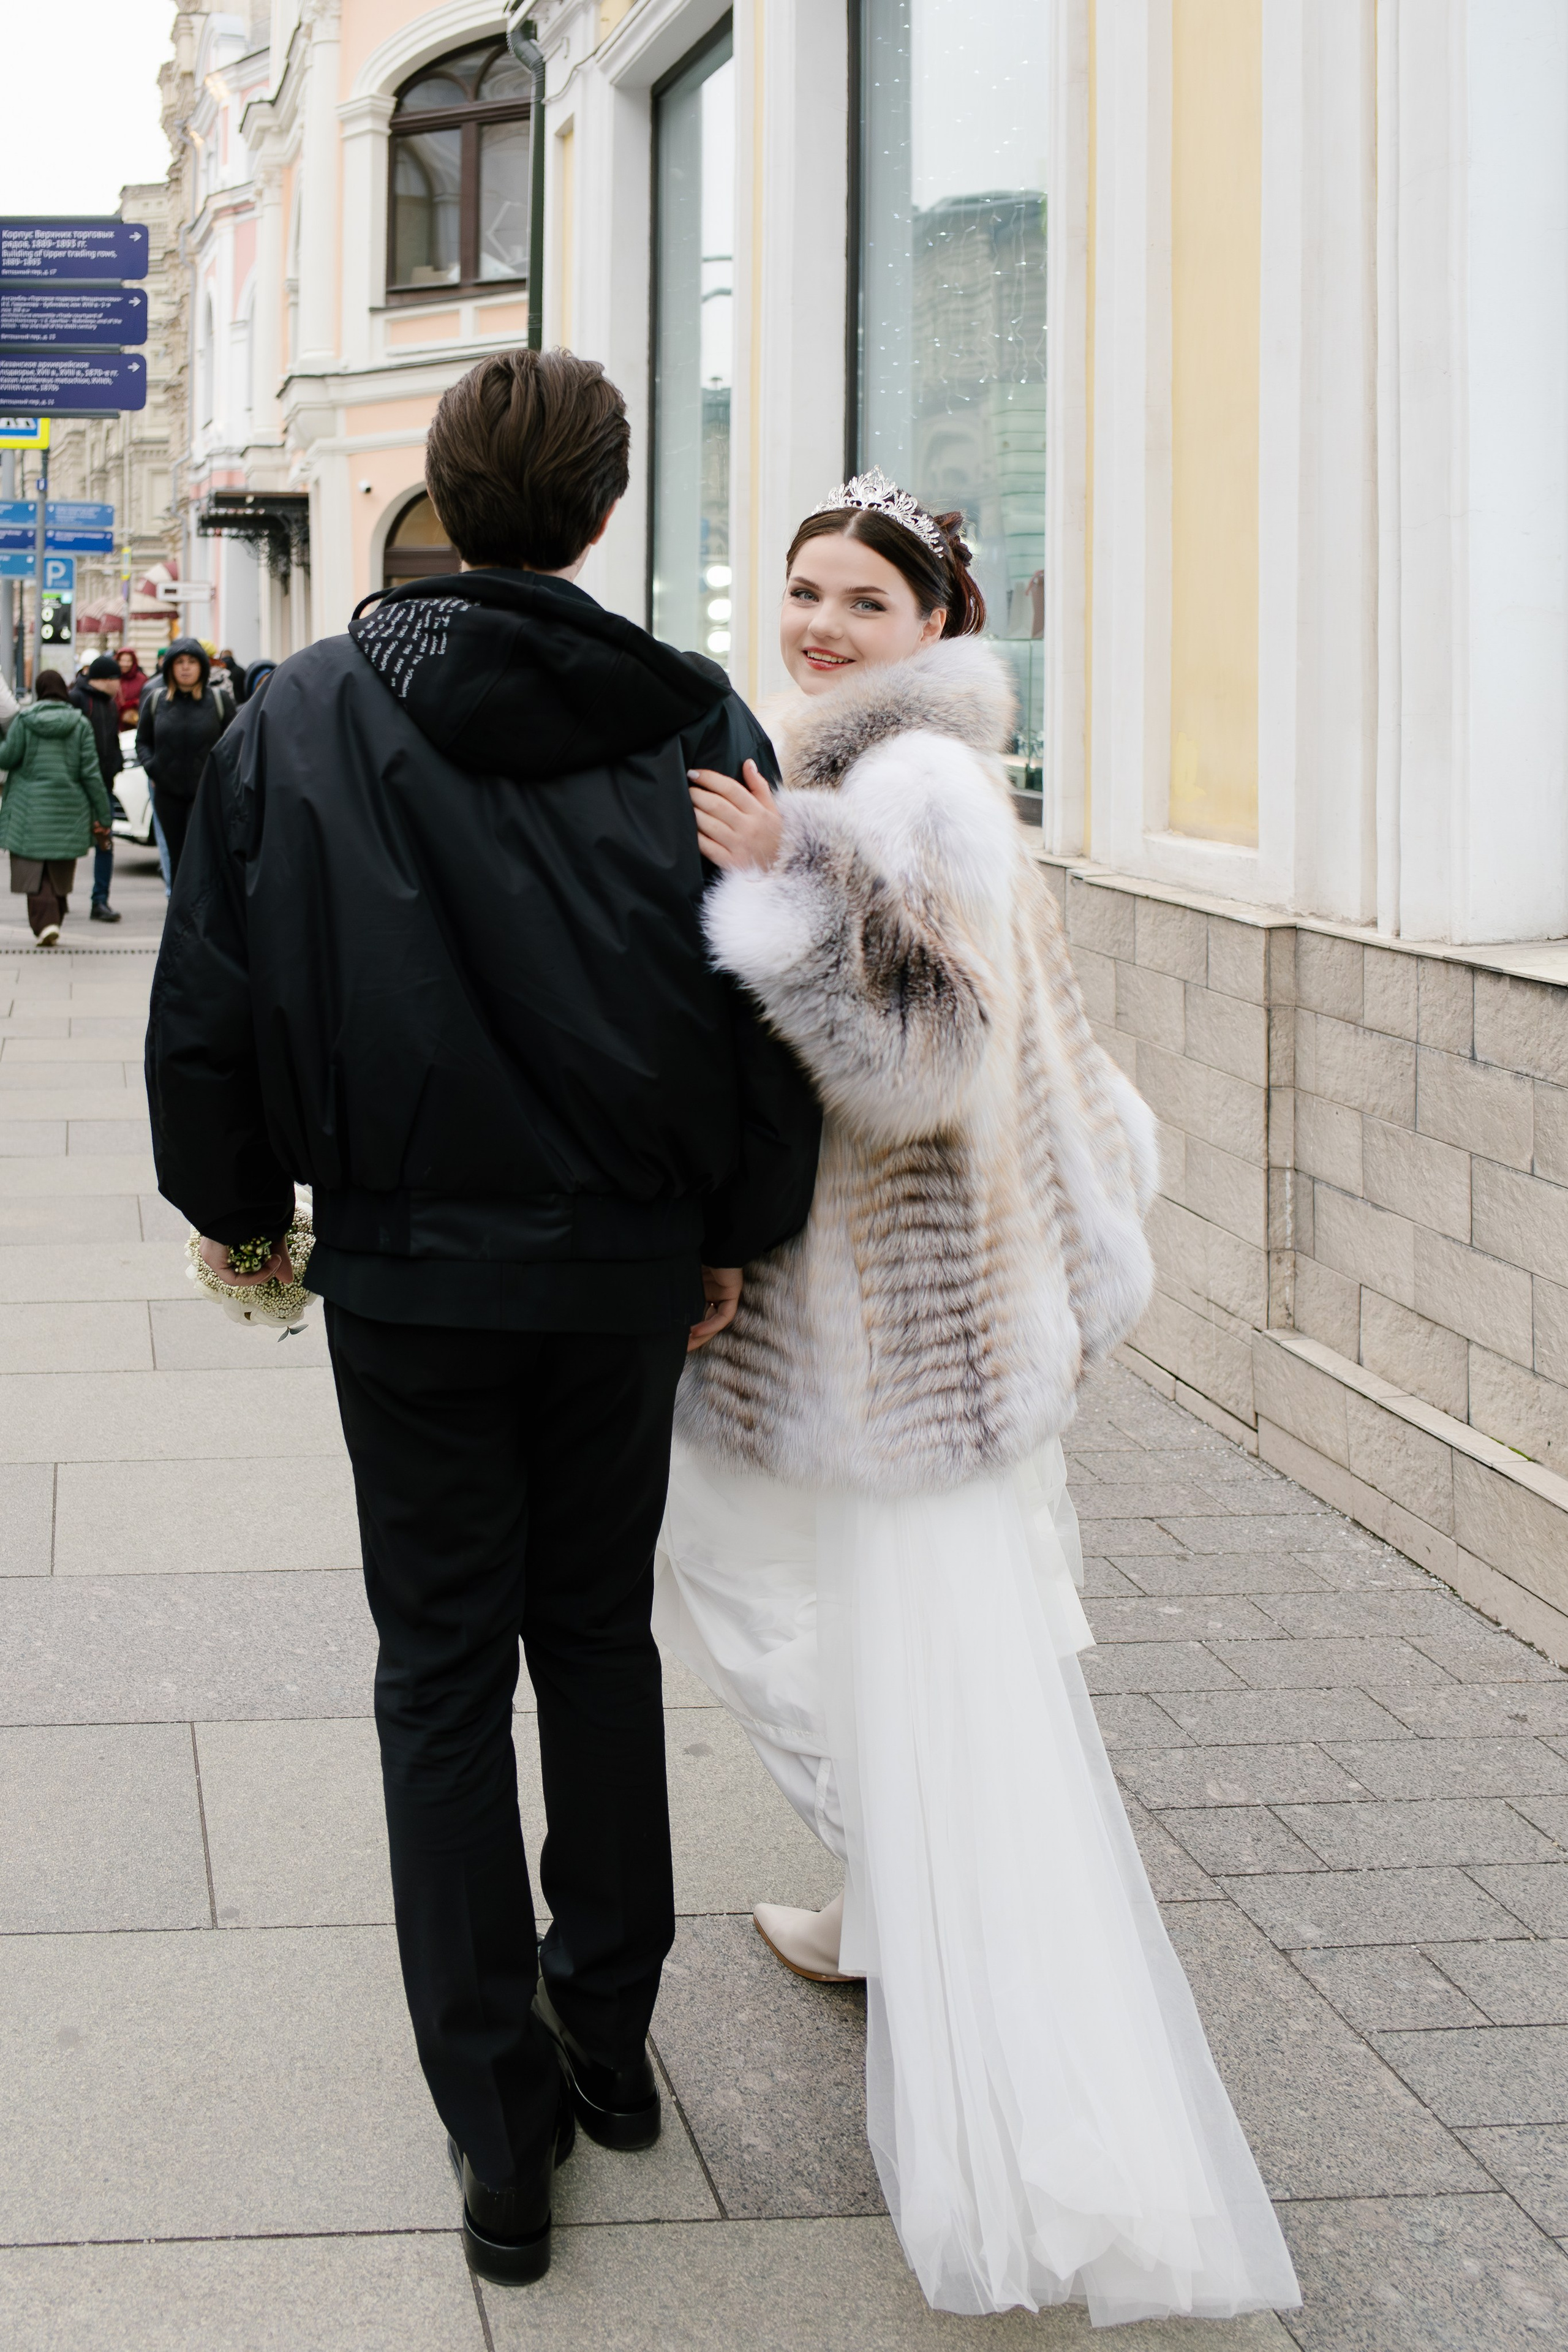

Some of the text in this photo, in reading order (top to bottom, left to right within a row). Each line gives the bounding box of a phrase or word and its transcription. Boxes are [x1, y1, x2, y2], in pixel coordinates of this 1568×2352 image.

[2, 230, 115, 240] Корпус Верхних торговых
[2, 249, 34, 258] Building
[43, 250, 67, 259] Upper
[67, 250, 96, 259] trading
[97, 251, 118, 259] rows,
[47, 560, 66, 588] P
